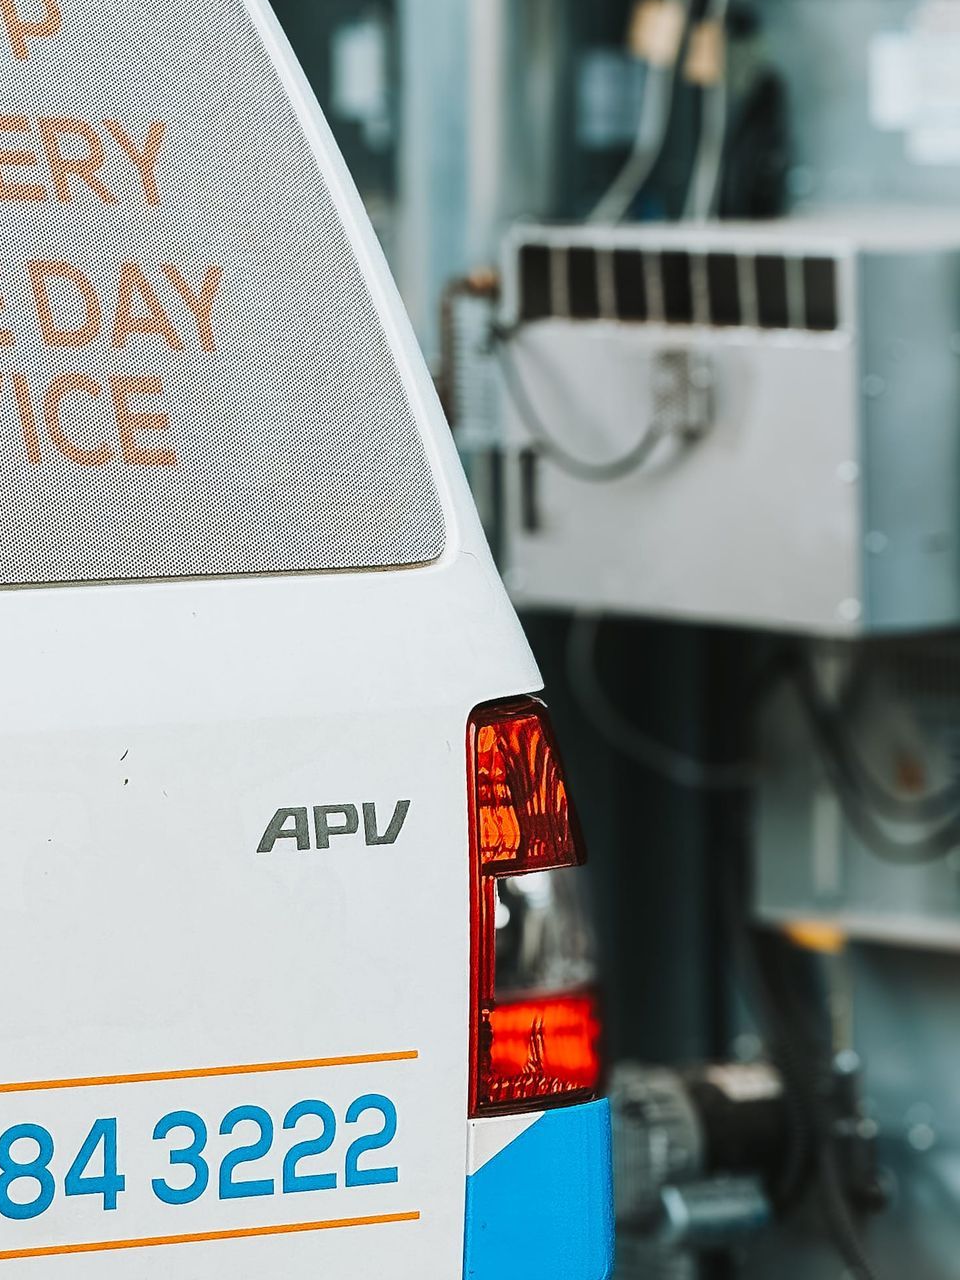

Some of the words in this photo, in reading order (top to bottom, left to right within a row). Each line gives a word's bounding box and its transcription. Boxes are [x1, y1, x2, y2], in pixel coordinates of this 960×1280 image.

[27, 259, 224, 353] DAY
[257, 799, 411, 854] APV
[152, 1093, 400, 1206] 3222
